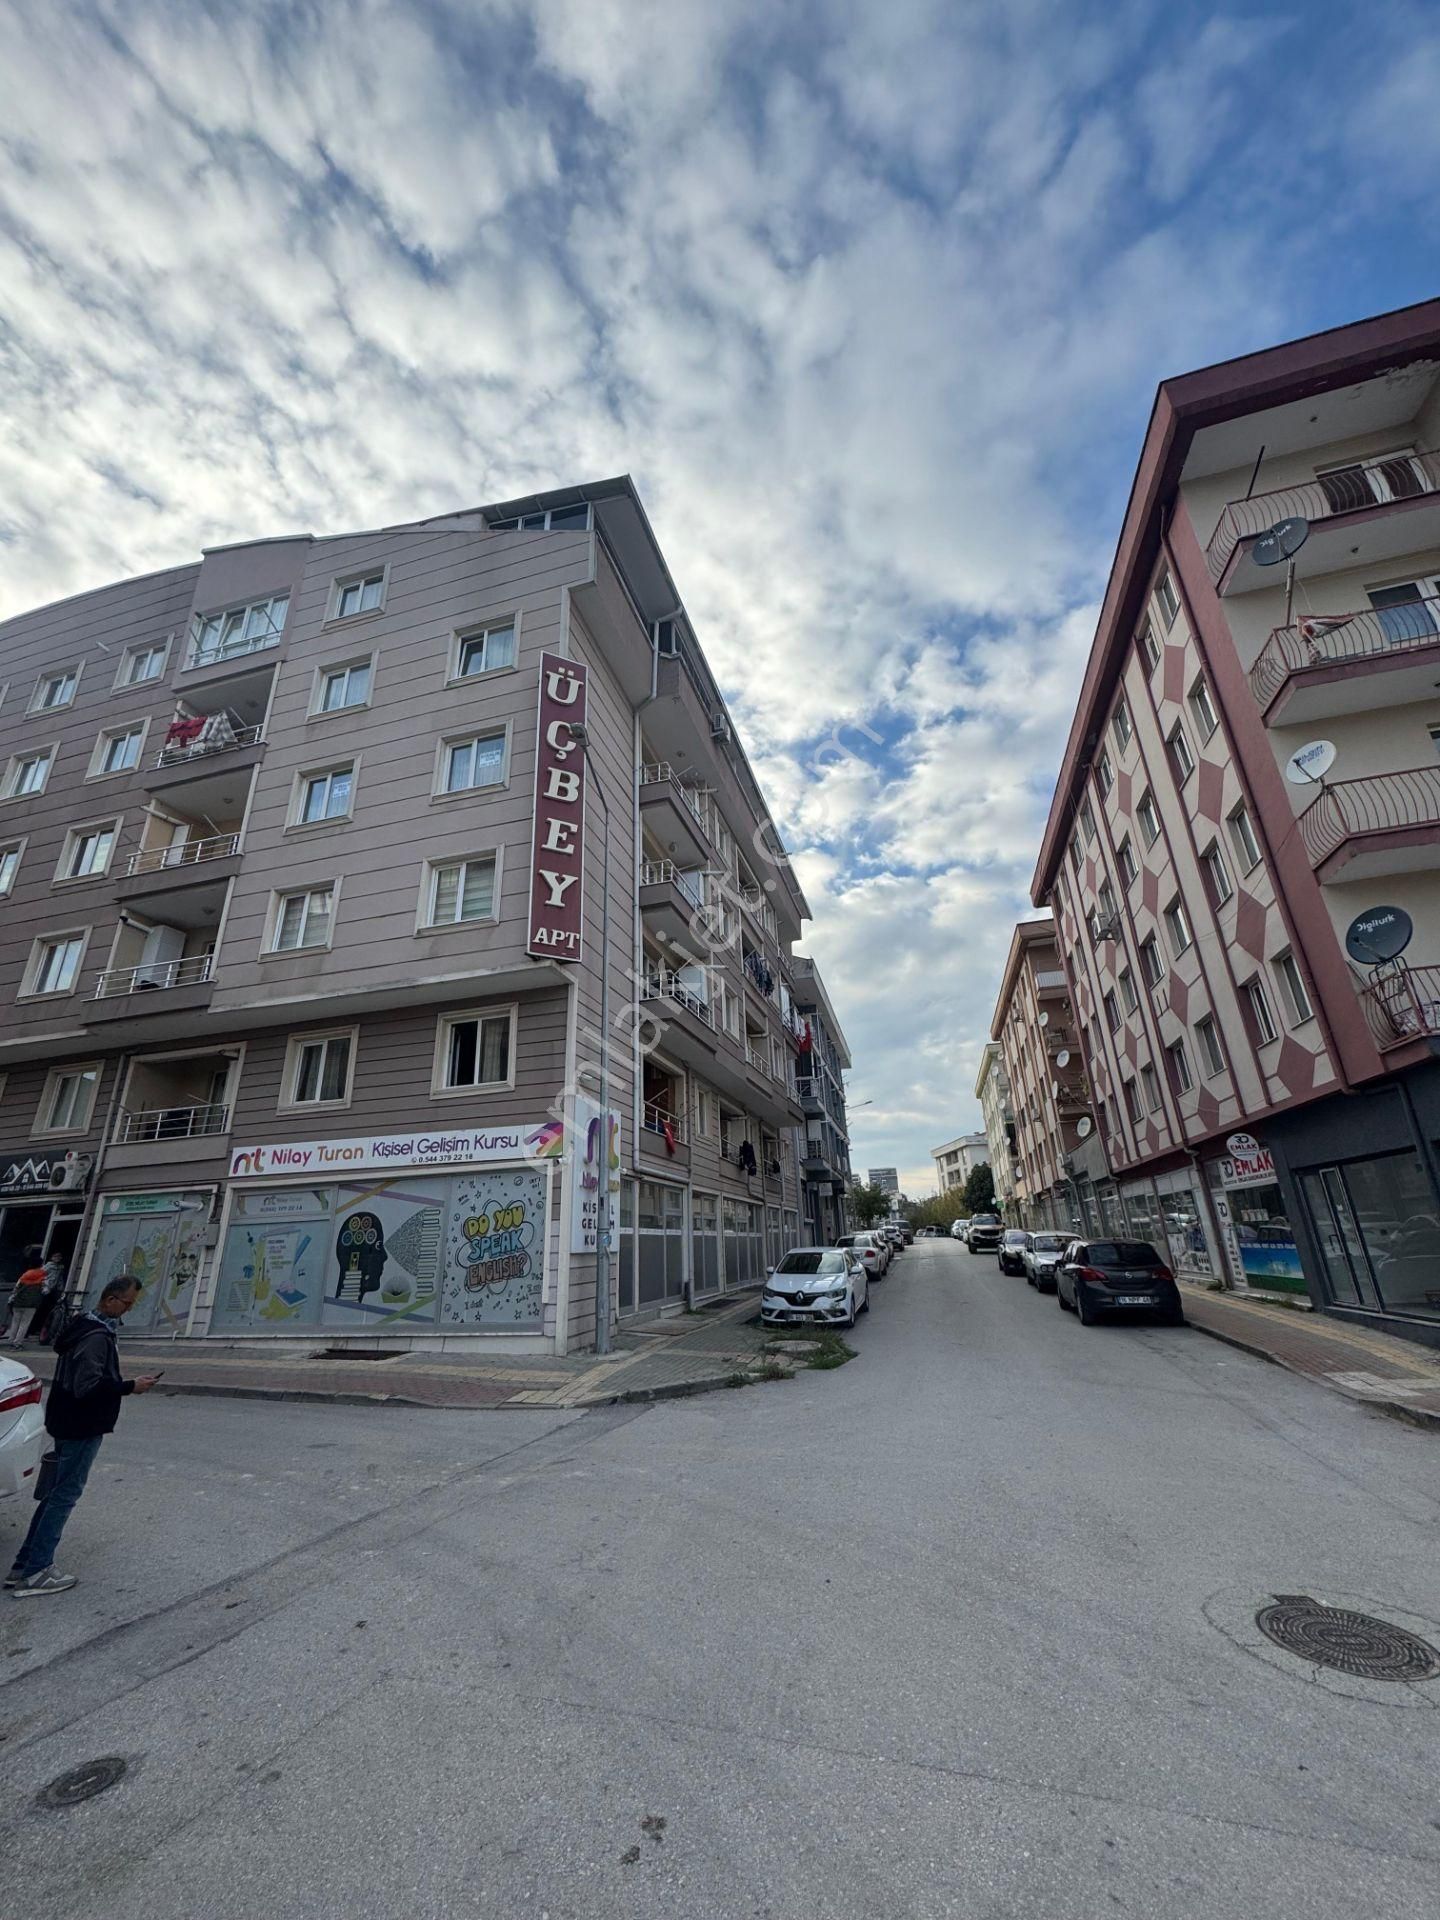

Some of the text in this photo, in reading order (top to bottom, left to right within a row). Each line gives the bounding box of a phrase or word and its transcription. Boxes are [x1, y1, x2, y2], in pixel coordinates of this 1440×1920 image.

[539, 666, 584, 908] ÜÇBEY
[532, 927, 580, 950] APT
[271, 1149, 312, 1167] Nilay
[317, 1145, 364, 1162] Turan
[372, 1139, 414, 1158] Kişisel
[417, 1136, 470, 1154] Gelişim
[474, 1133, 519, 1150] Kursu
[1234, 1151, 1274, 1176] EMLAK
[466, 1204, 525, 1239] DO YOU
[467, 1228, 525, 1263] SPEAK
[466, 1253, 530, 1290] ENGLISH?
